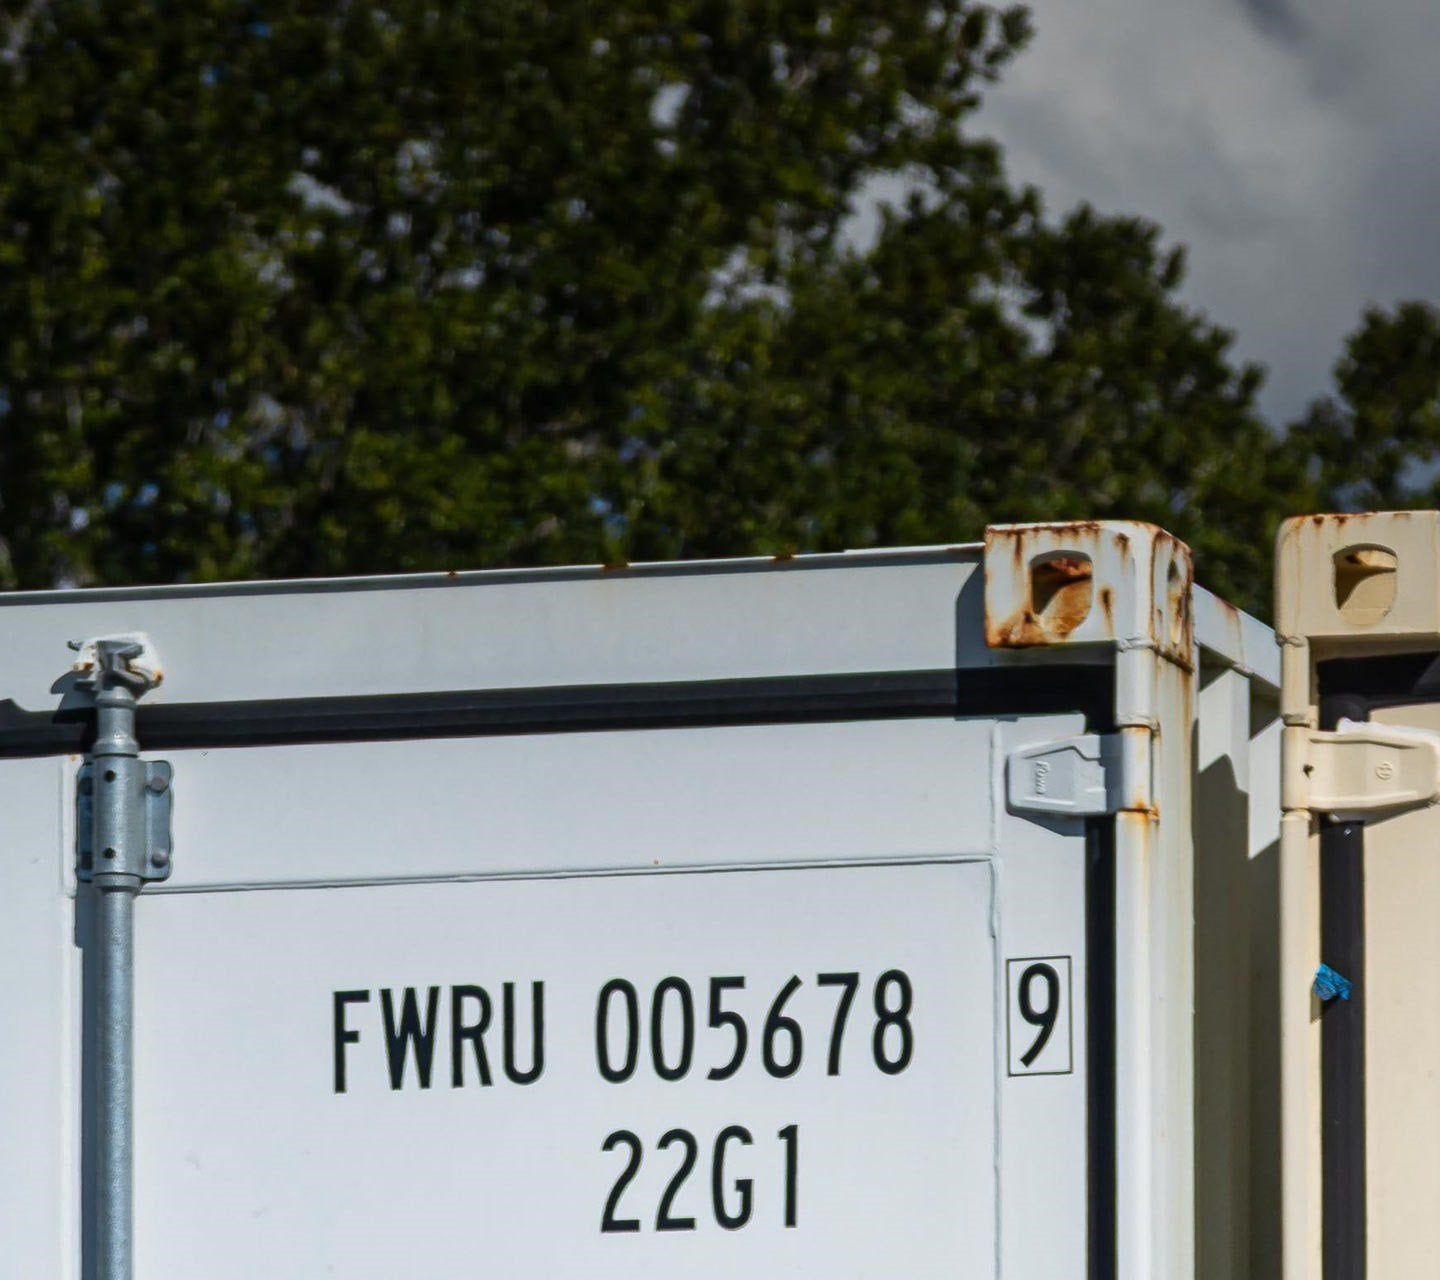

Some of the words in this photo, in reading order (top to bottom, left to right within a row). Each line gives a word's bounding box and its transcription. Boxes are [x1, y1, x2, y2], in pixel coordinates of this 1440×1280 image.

[333, 980, 546, 1094] FWRU
[595, 968, 915, 1084] 005678
[1017, 962, 1061, 1068] 9
[600, 1123, 799, 1233] 22G1
